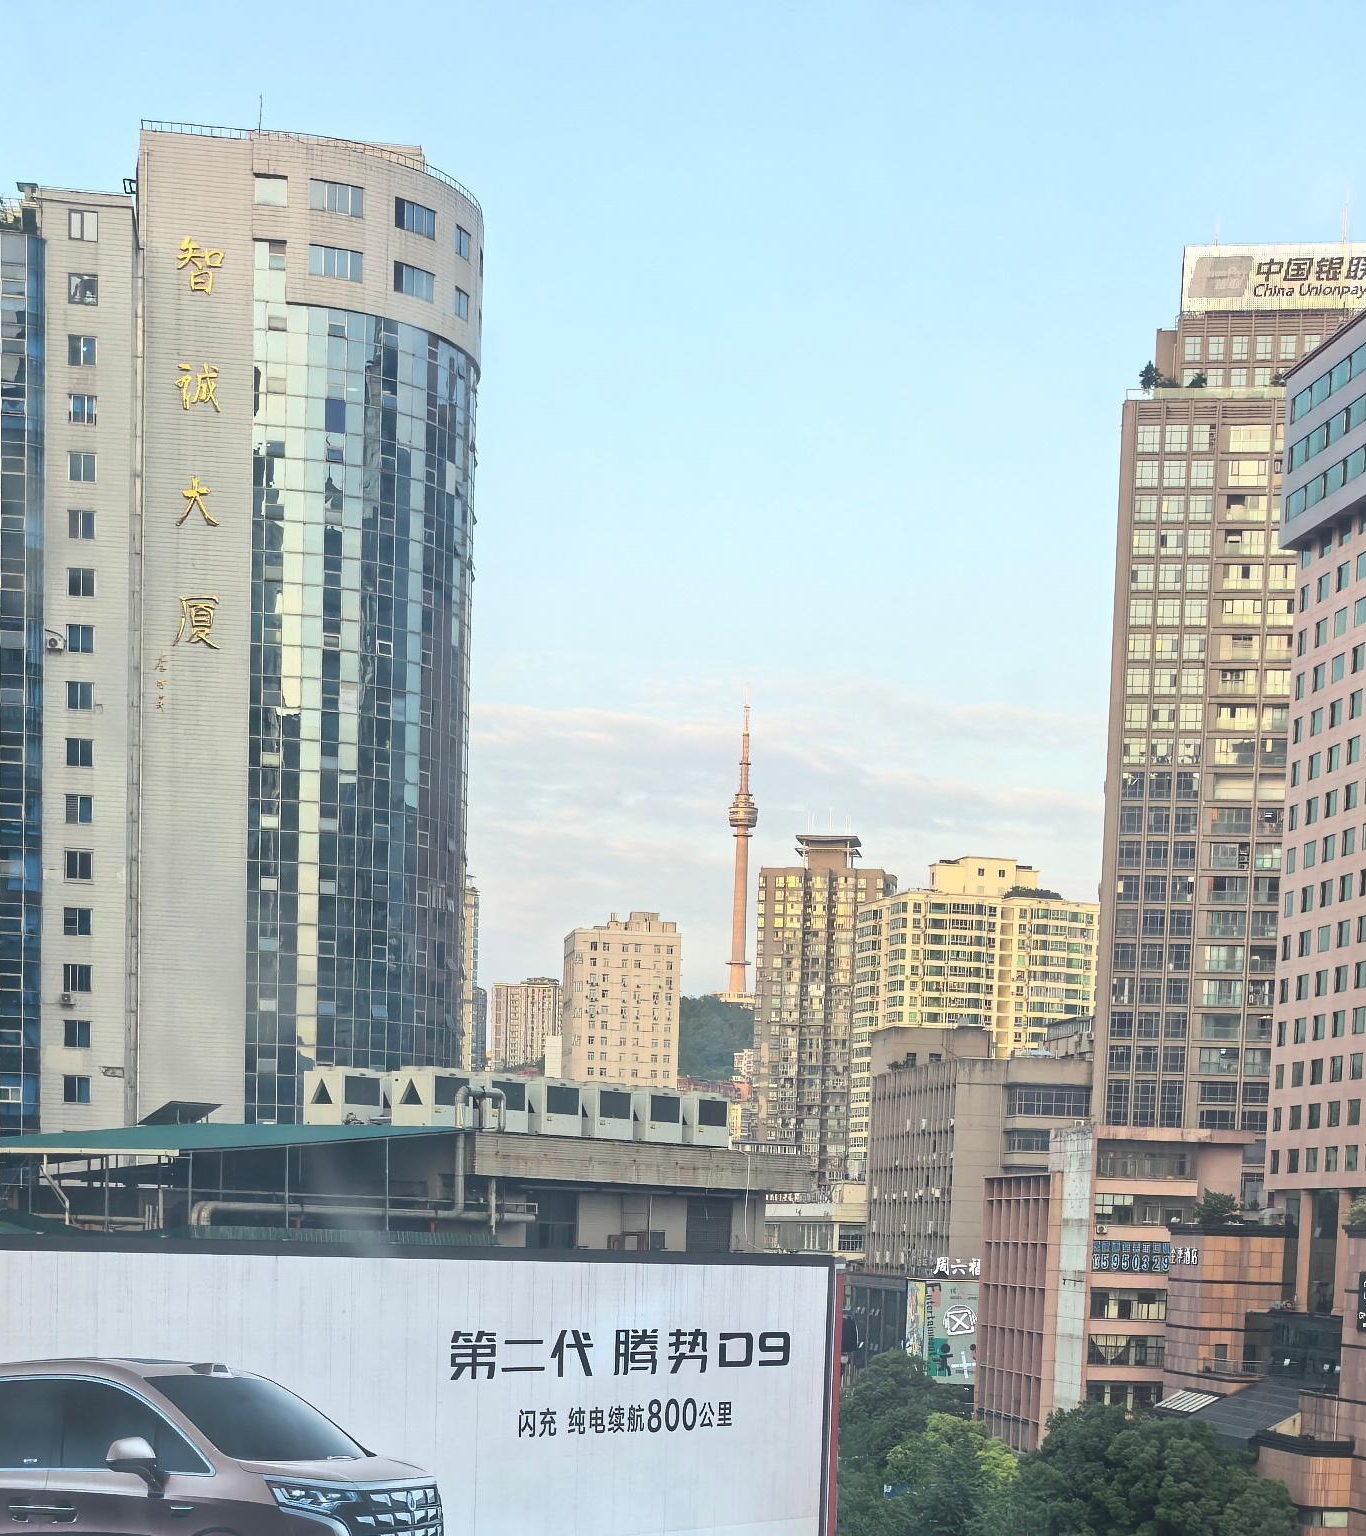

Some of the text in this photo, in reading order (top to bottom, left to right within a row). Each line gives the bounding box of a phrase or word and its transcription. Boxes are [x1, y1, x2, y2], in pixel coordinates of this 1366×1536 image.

[1253, 283, 1295, 298] China
[449, 1328, 792, 1381] 第二代 腾势D9
[517, 1397, 734, 1439] 闪充 纯电续航800公里
